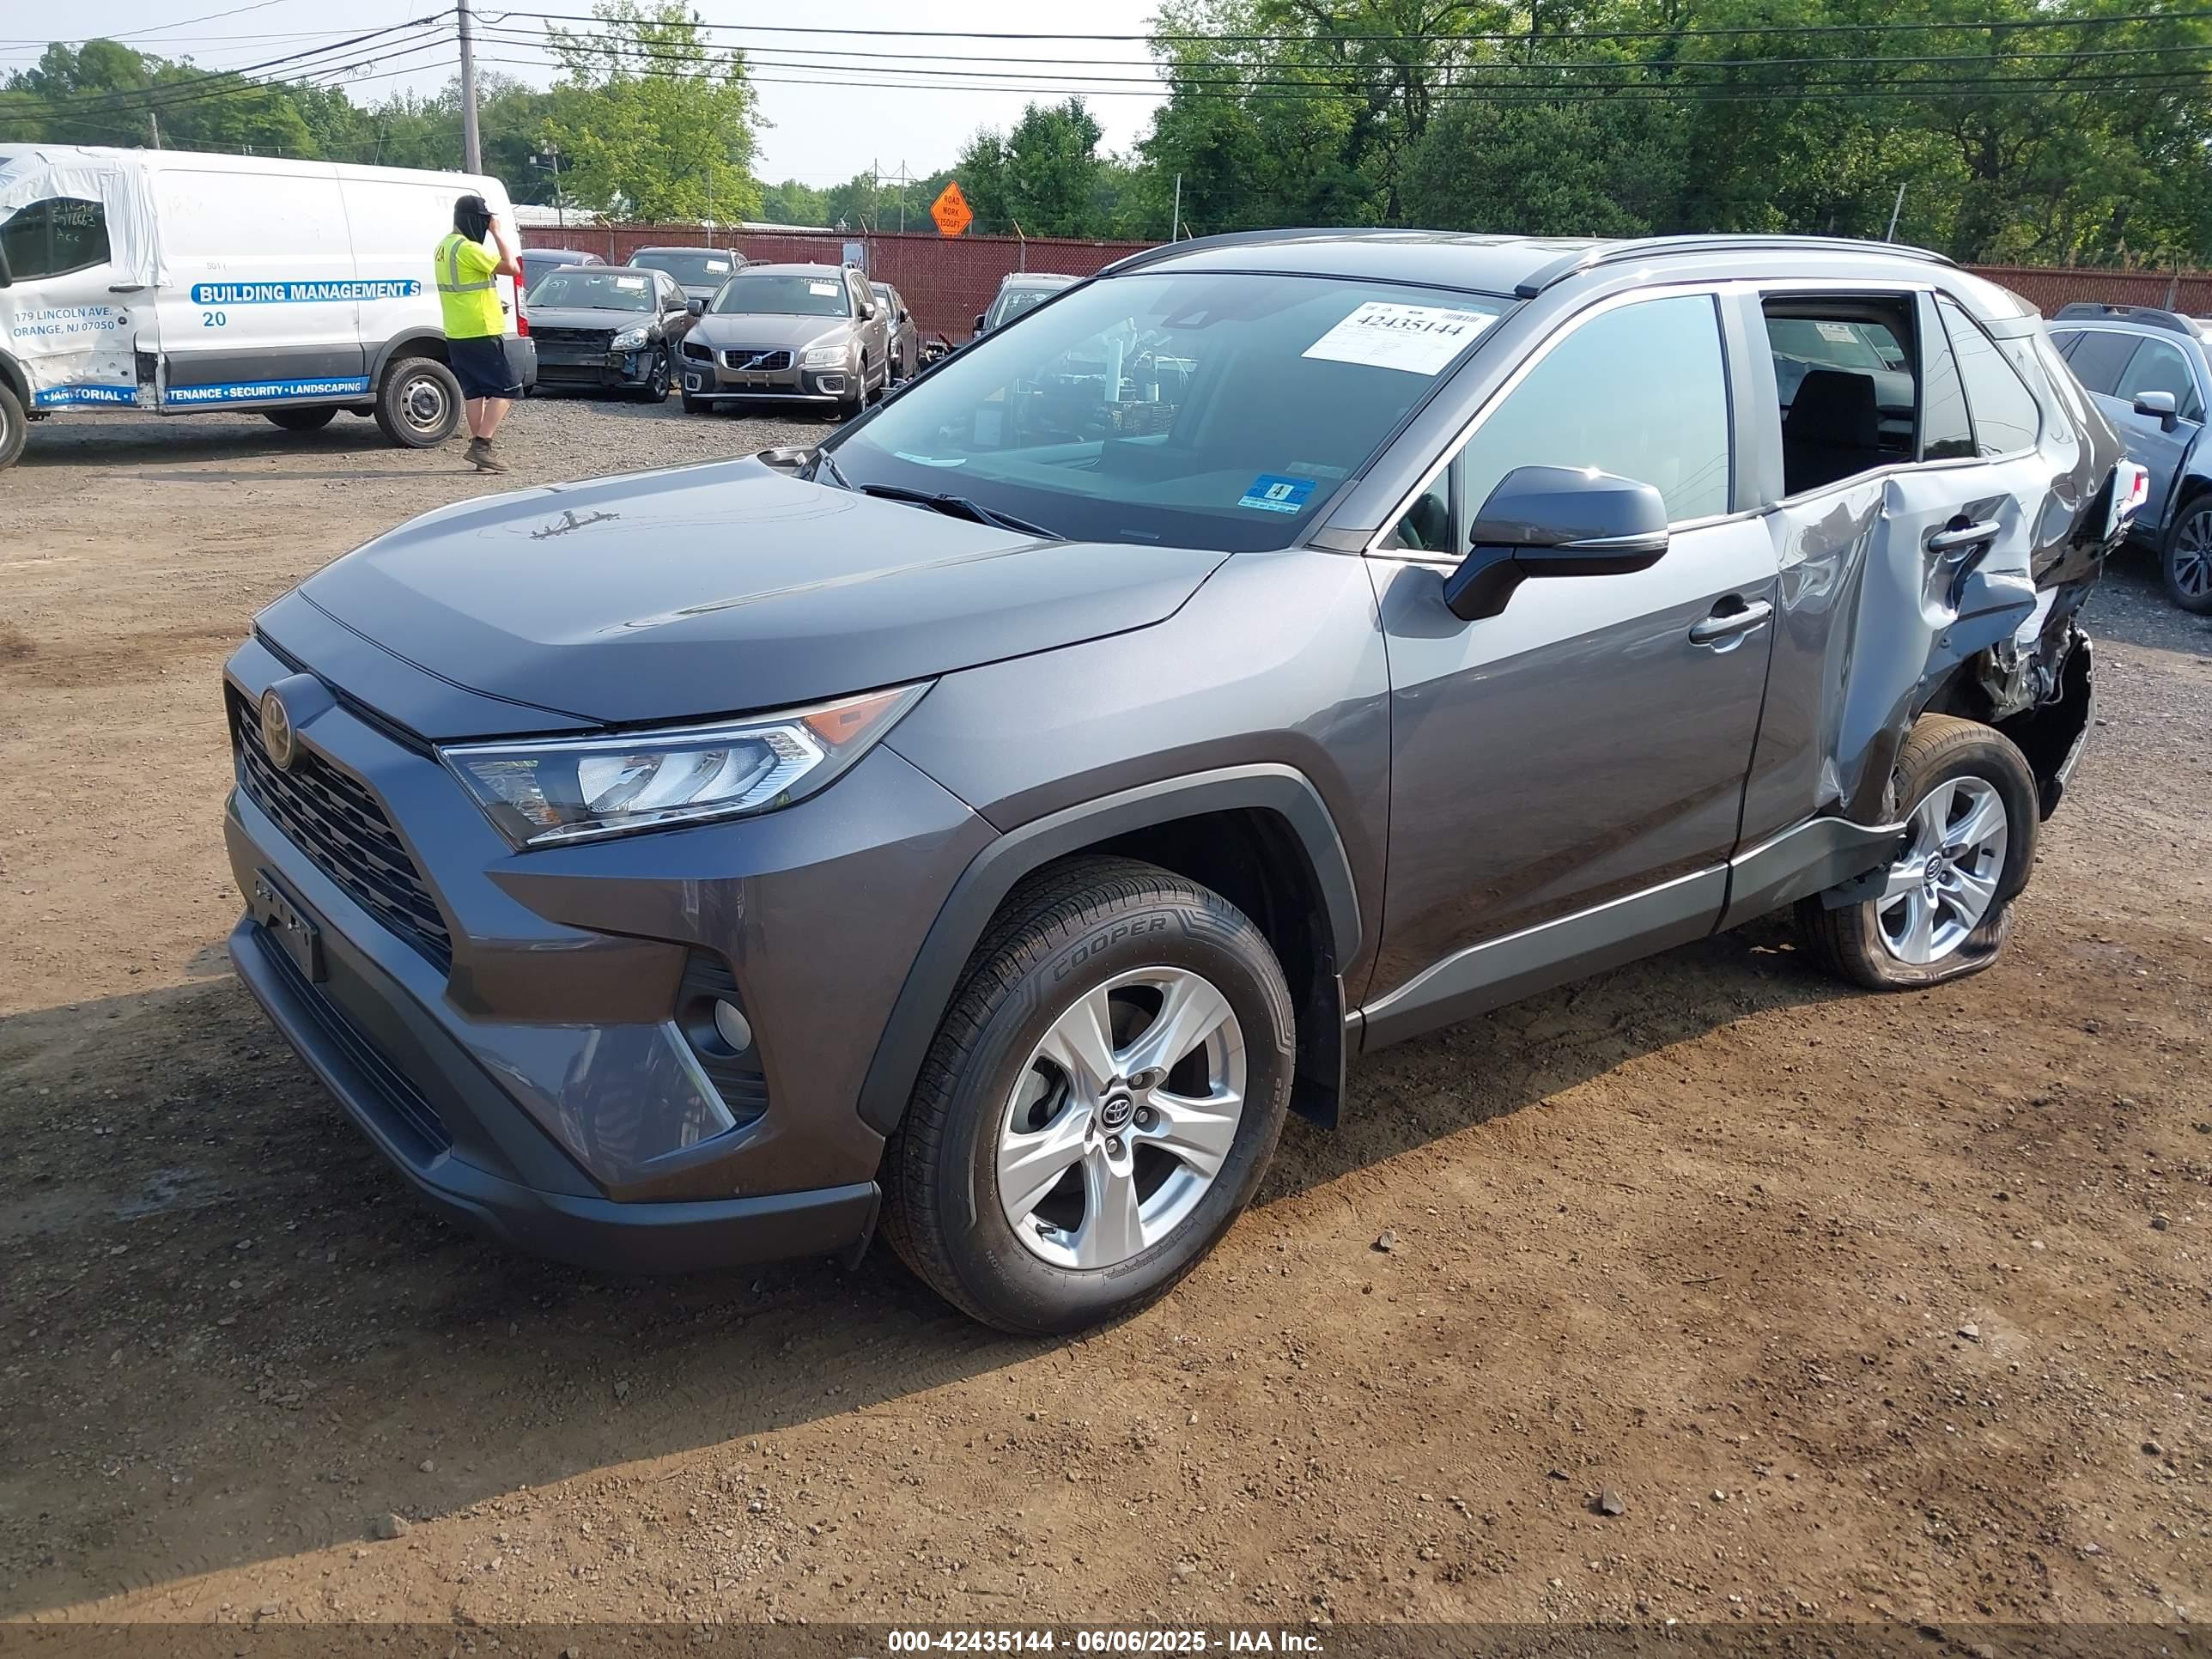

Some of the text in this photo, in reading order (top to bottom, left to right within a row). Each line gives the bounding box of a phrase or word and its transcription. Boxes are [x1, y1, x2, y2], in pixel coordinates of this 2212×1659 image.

[945, 195, 960, 205] ROAD
[943, 207, 959, 216] WORK
[198, 282, 421, 302] BUILDING MANAGEMENT S
[15, 307, 113, 323] 179 LINCOLN AVE.
[202, 311, 227, 327] 20
[14, 320, 115, 338] ORANGE, NJ 07050
[1357, 314, 1467, 337] 42435144
[229, 386, 283, 398] SECURITY
[289, 382, 362, 395] LANDSCAPING
[1053, 916, 1167, 982] COOPER
